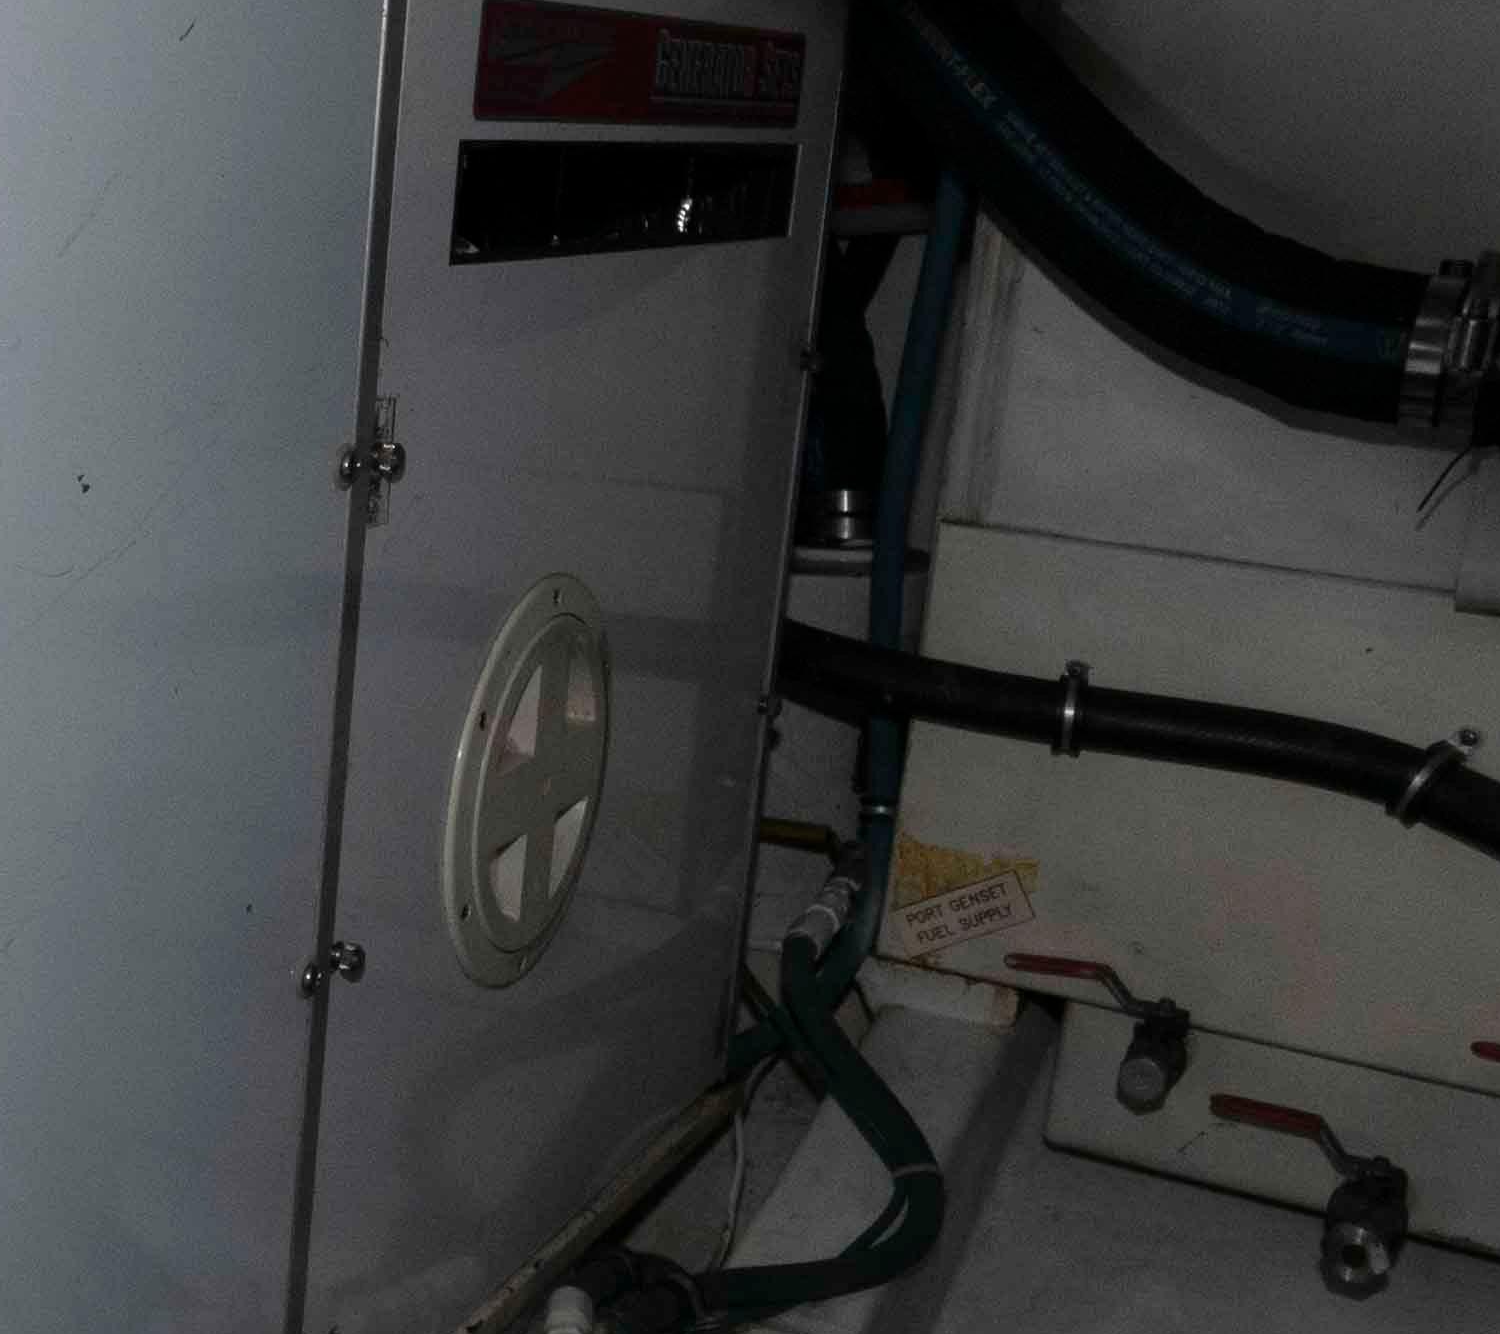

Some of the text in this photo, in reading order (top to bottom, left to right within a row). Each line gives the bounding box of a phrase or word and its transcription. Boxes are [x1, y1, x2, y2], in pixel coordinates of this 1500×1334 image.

[906, 883, 1007, 927] PORT GENSET
[917, 903, 1013, 943] FUEL SUPPLY
